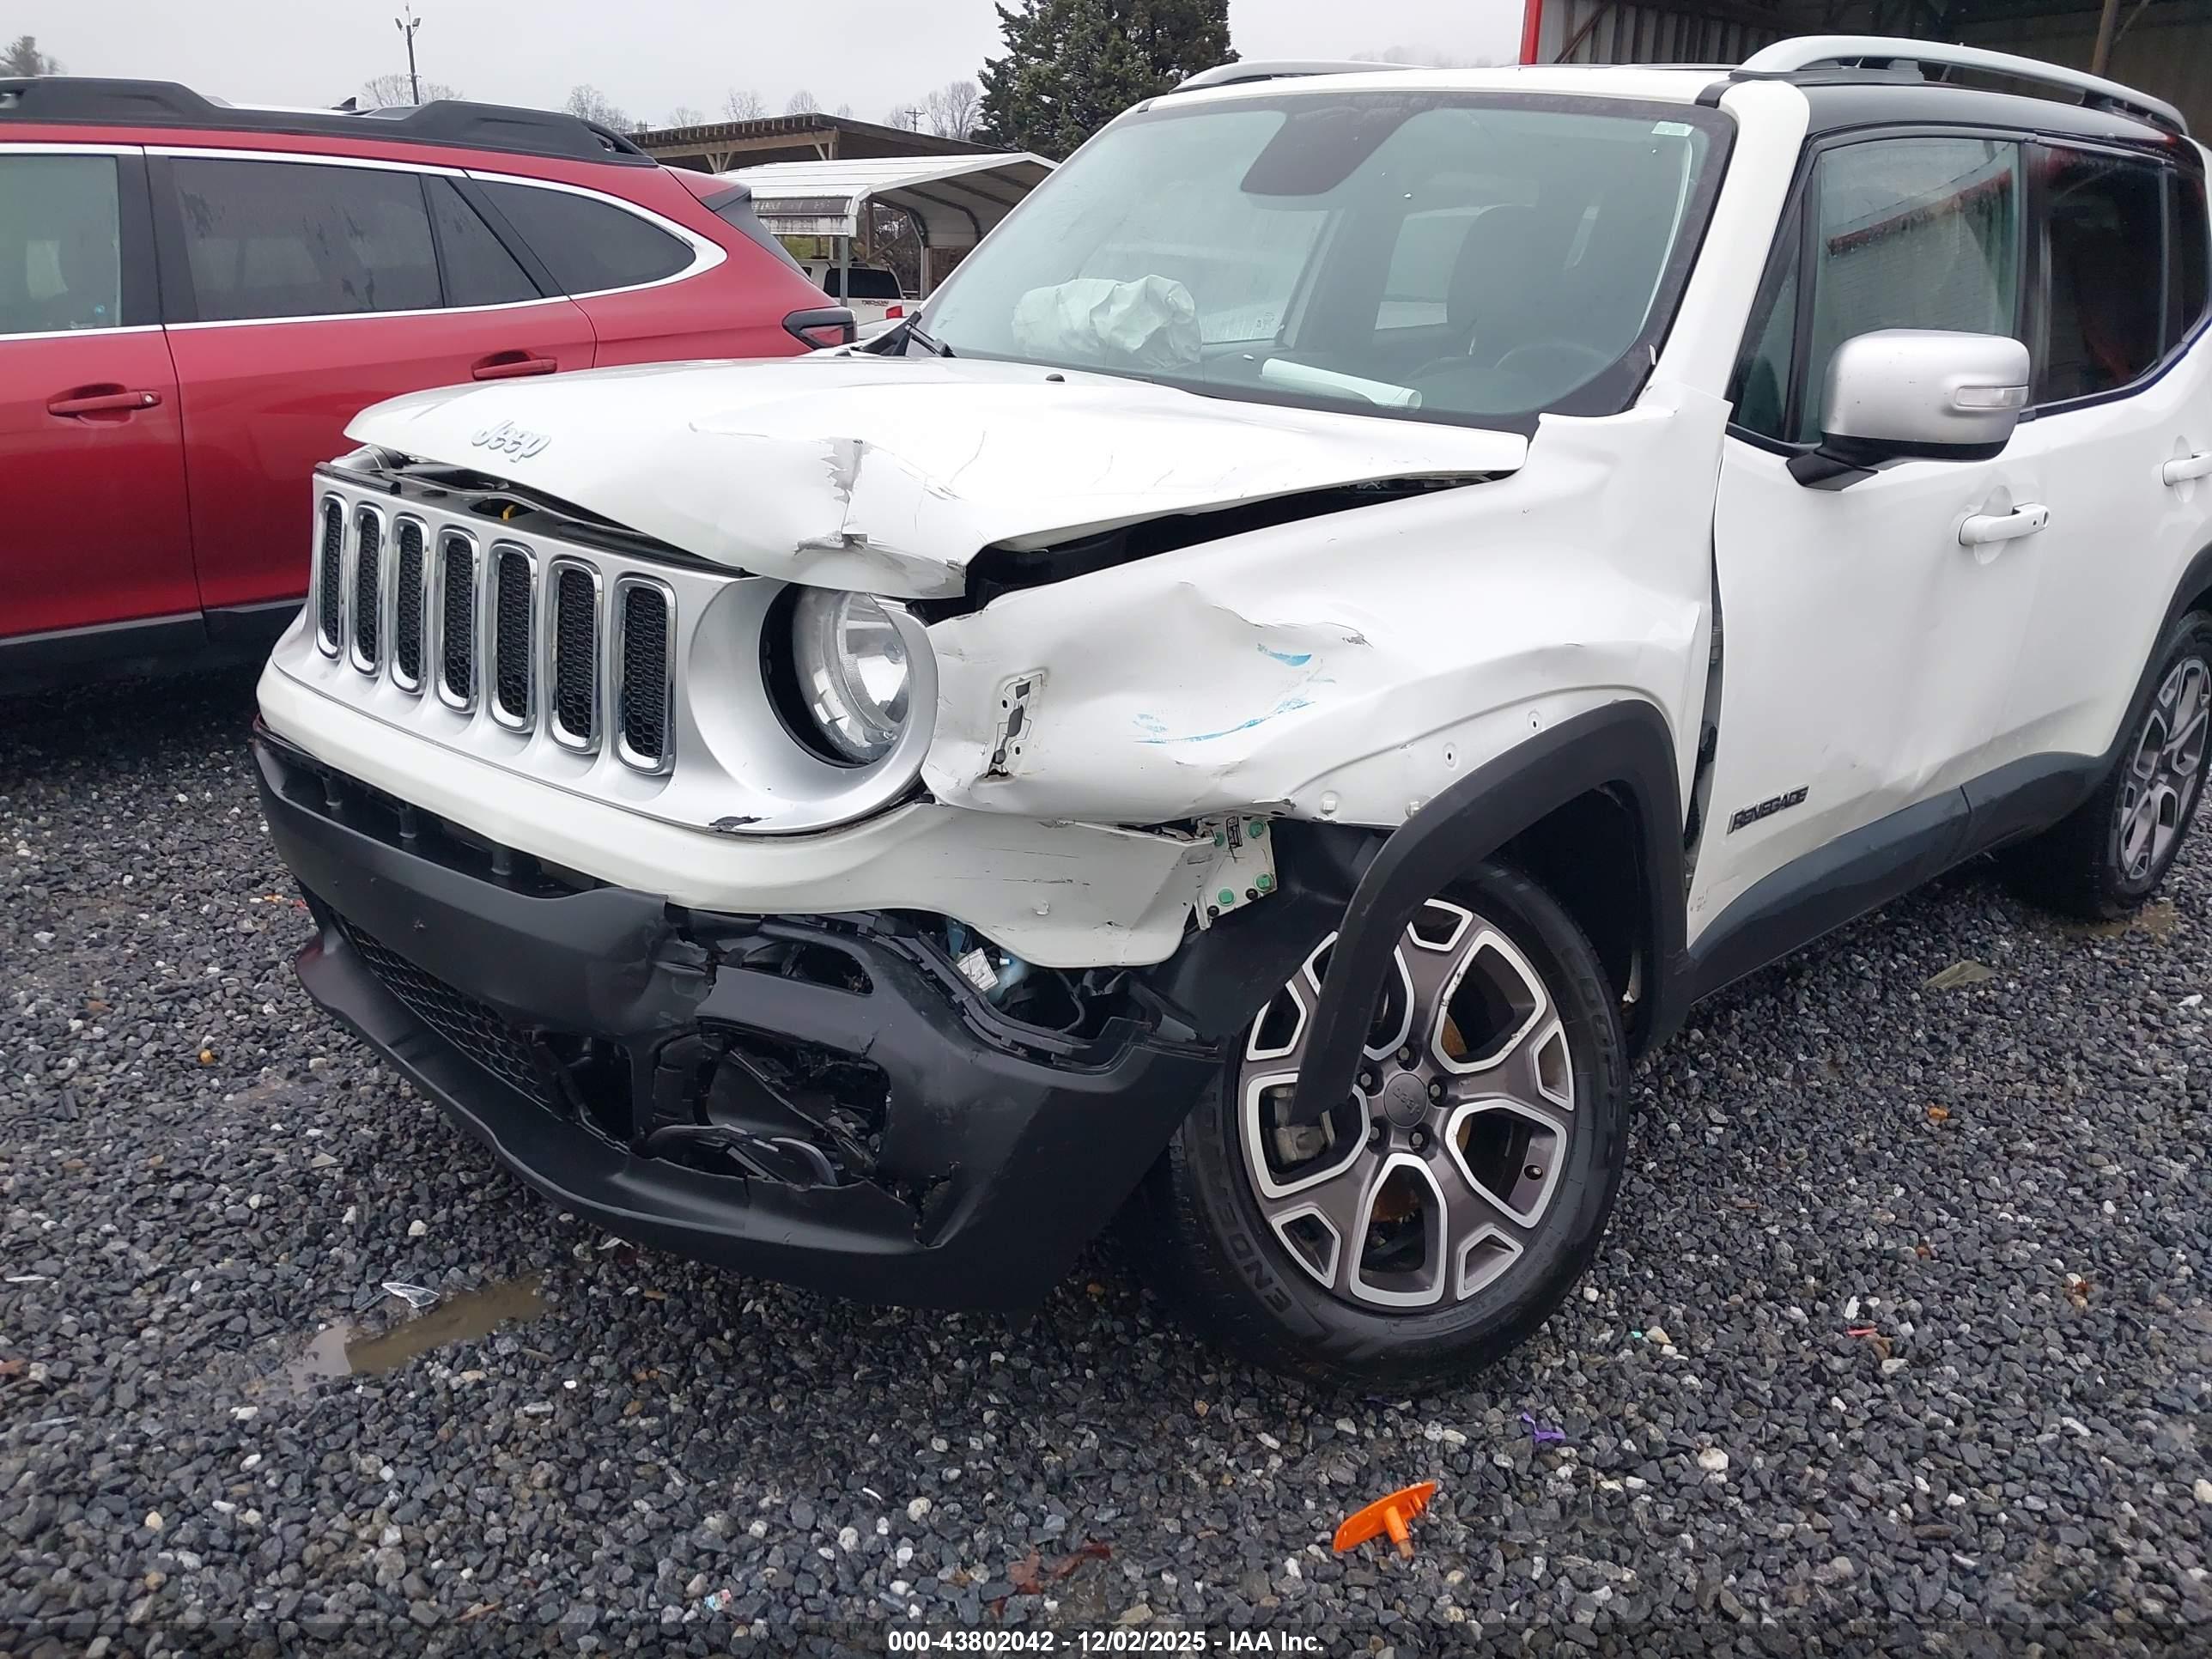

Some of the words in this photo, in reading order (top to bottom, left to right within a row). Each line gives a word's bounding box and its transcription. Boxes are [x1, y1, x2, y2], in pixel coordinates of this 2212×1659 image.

[471, 419, 551, 463] Jeep
[1726, 785, 1810, 835] RENEGADE
[1392, 1085, 1421, 1116] Jeep
